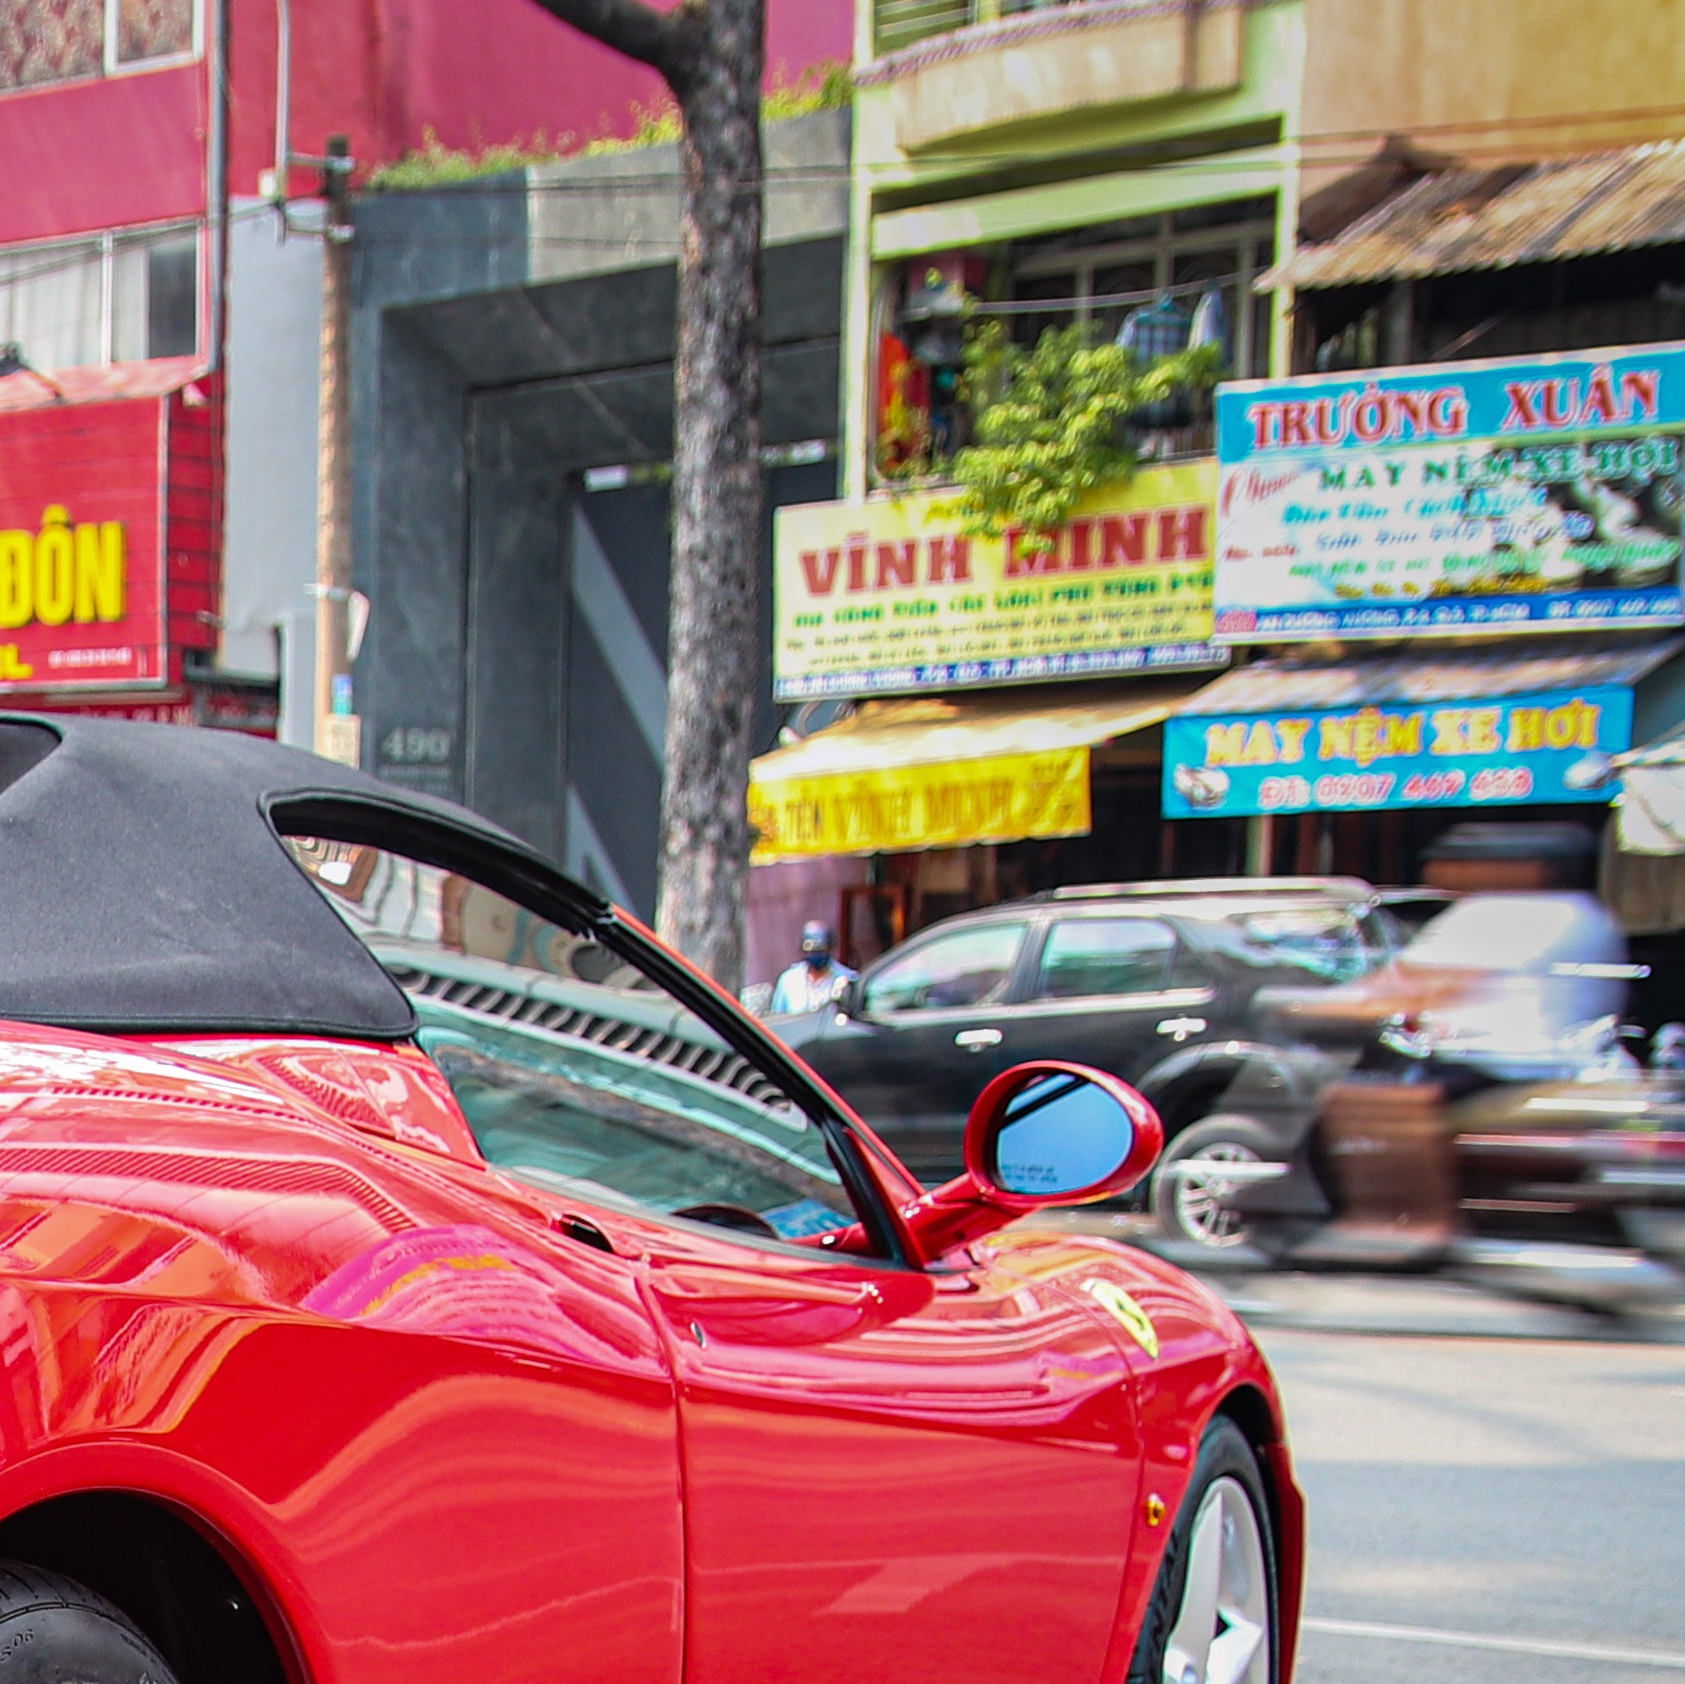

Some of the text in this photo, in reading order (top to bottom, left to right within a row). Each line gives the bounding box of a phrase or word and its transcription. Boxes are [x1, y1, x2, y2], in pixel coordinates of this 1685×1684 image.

[1501, 363, 1661, 431] XUÂN
[1320, 461, 1405, 490] MAY
[799, 529, 975, 598] VĨNH
[1003, 505, 1208, 579] MINH
[1205, 697, 1603, 768] MAY NỆM XE HƠI
